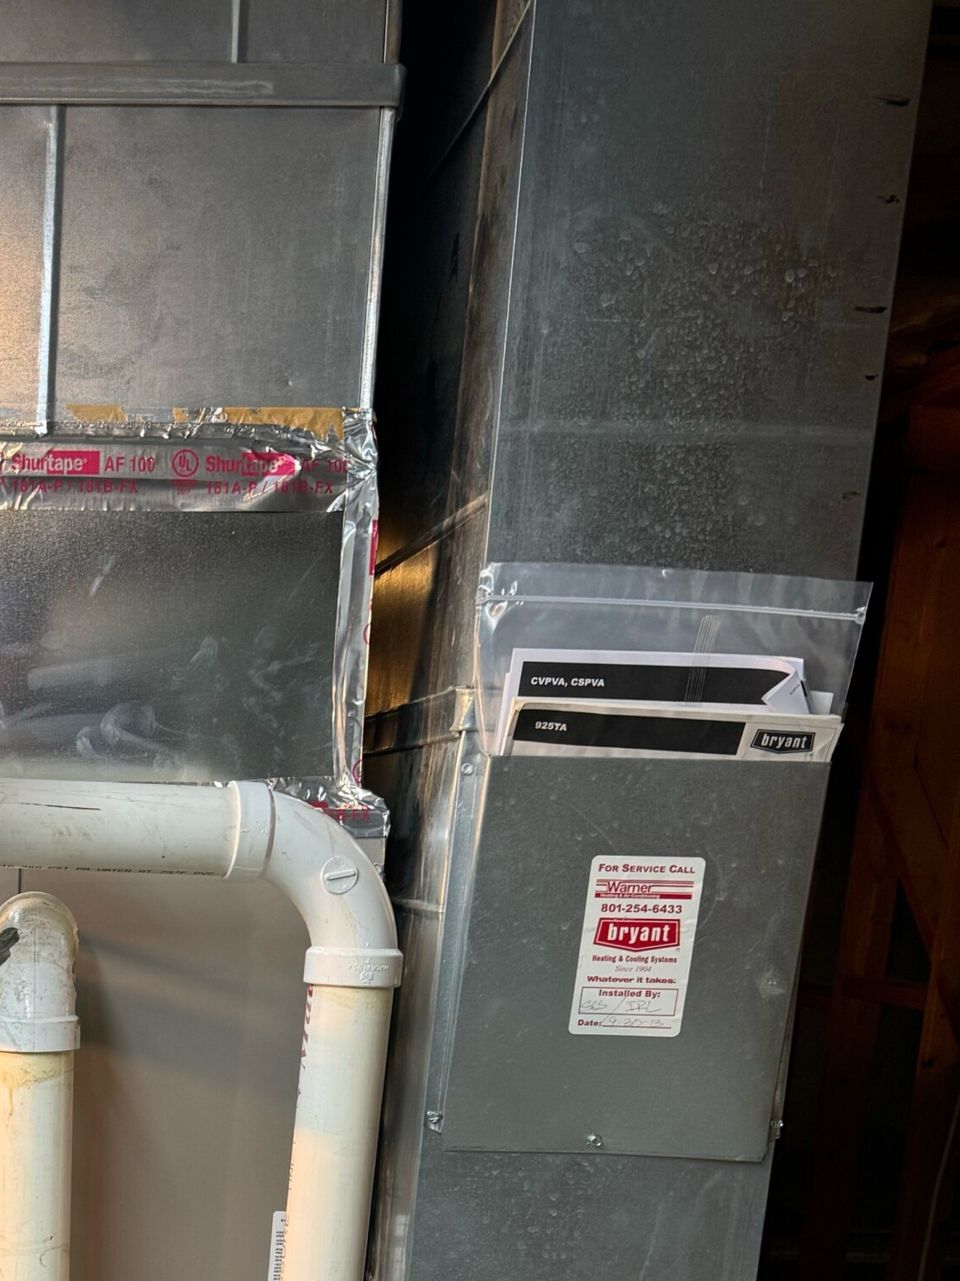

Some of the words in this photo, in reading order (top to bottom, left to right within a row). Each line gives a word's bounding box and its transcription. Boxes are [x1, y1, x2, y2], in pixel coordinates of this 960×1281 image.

[12, 453, 87, 476] Shurtape
[104, 455, 124, 473] AF
[130, 456, 155, 473] 100
[12, 480, 63, 494] 181A-P
[79, 479, 138, 493] 181B-FX
[207, 481, 257, 494] 181A-P
[530, 676, 569, 688] CVPVA,
[570, 676, 606, 688] CSPVA
[760, 733, 809, 750] bryant
[598, 863, 619, 872] FOR
[622, 863, 666, 873] SERVICE
[669, 865, 696, 874] CALL
[601, 903, 683, 914] 801-254-6433
[607, 923, 671, 945] bryant
[592, 955, 616, 963] Heating
[625, 955, 649, 964] Cooling
[650, 956, 677, 964] Systems
[598, 989, 642, 998] Installed
[644, 990, 661, 999] By:
[577, 1019, 602, 1027] Date:
